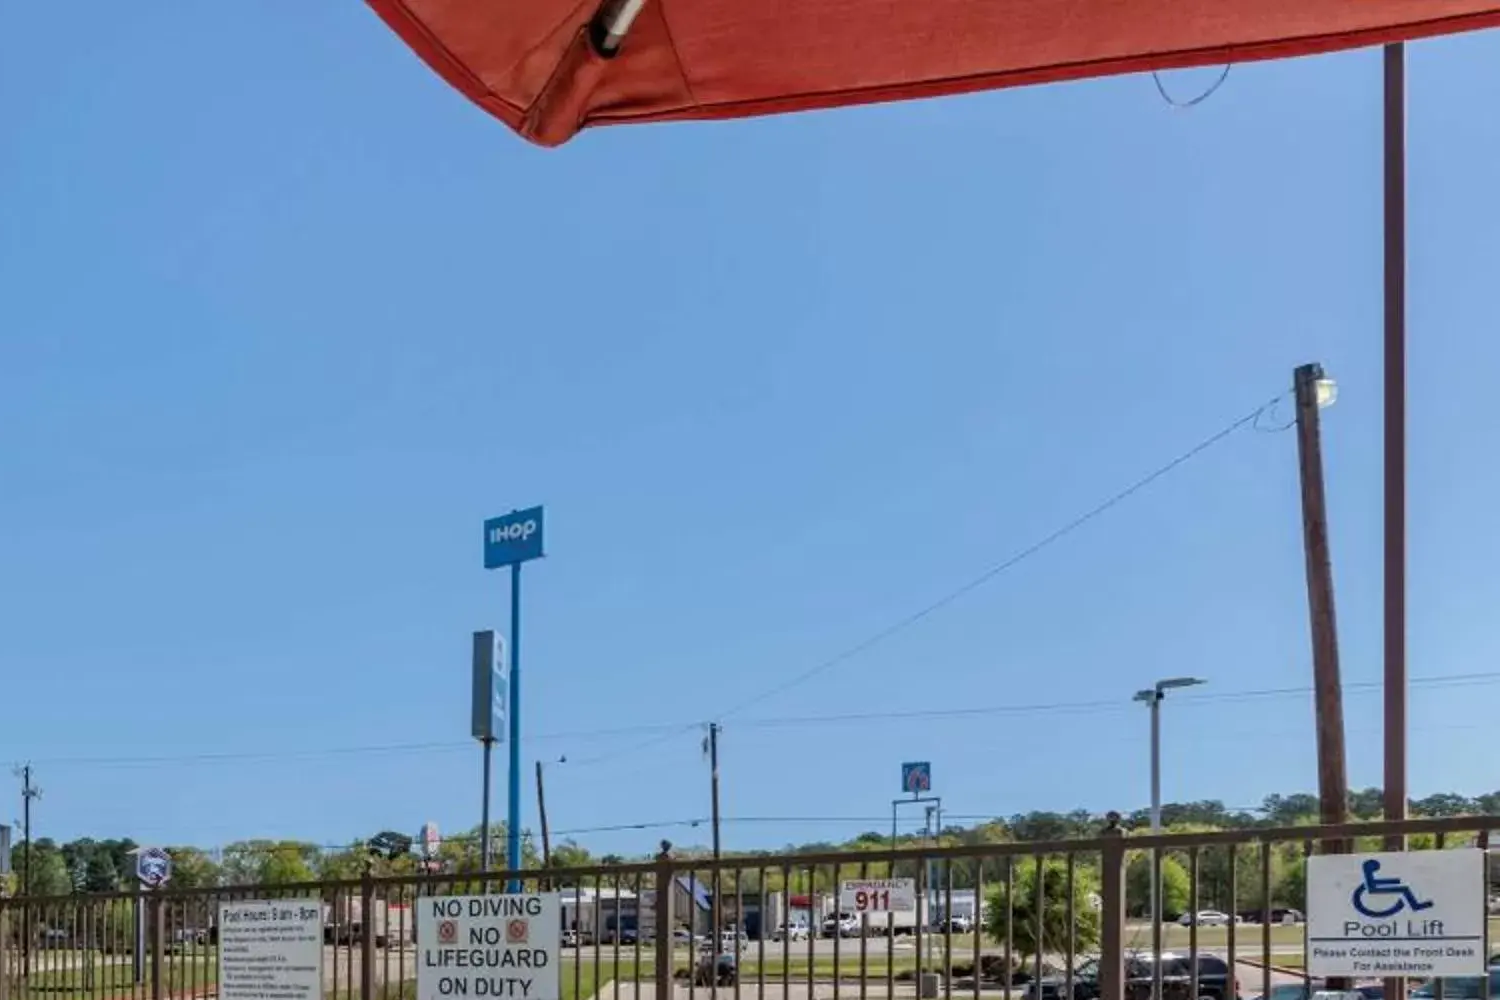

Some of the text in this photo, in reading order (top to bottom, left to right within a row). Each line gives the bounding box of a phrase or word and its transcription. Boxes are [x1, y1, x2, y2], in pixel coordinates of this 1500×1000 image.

[433, 897, 541, 917] NO DIVING
[856, 890, 889, 911] 911
[470, 927, 500, 945] NO
[1343, 920, 1444, 937] Pool Lift
[426, 949, 549, 968] LIFEGUARD
[1313, 947, 1474, 958] Please Contact the Front Desk
[1353, 961, 1433, 971] For Assistance
[439, 977, 532, 997] ON DUTY
